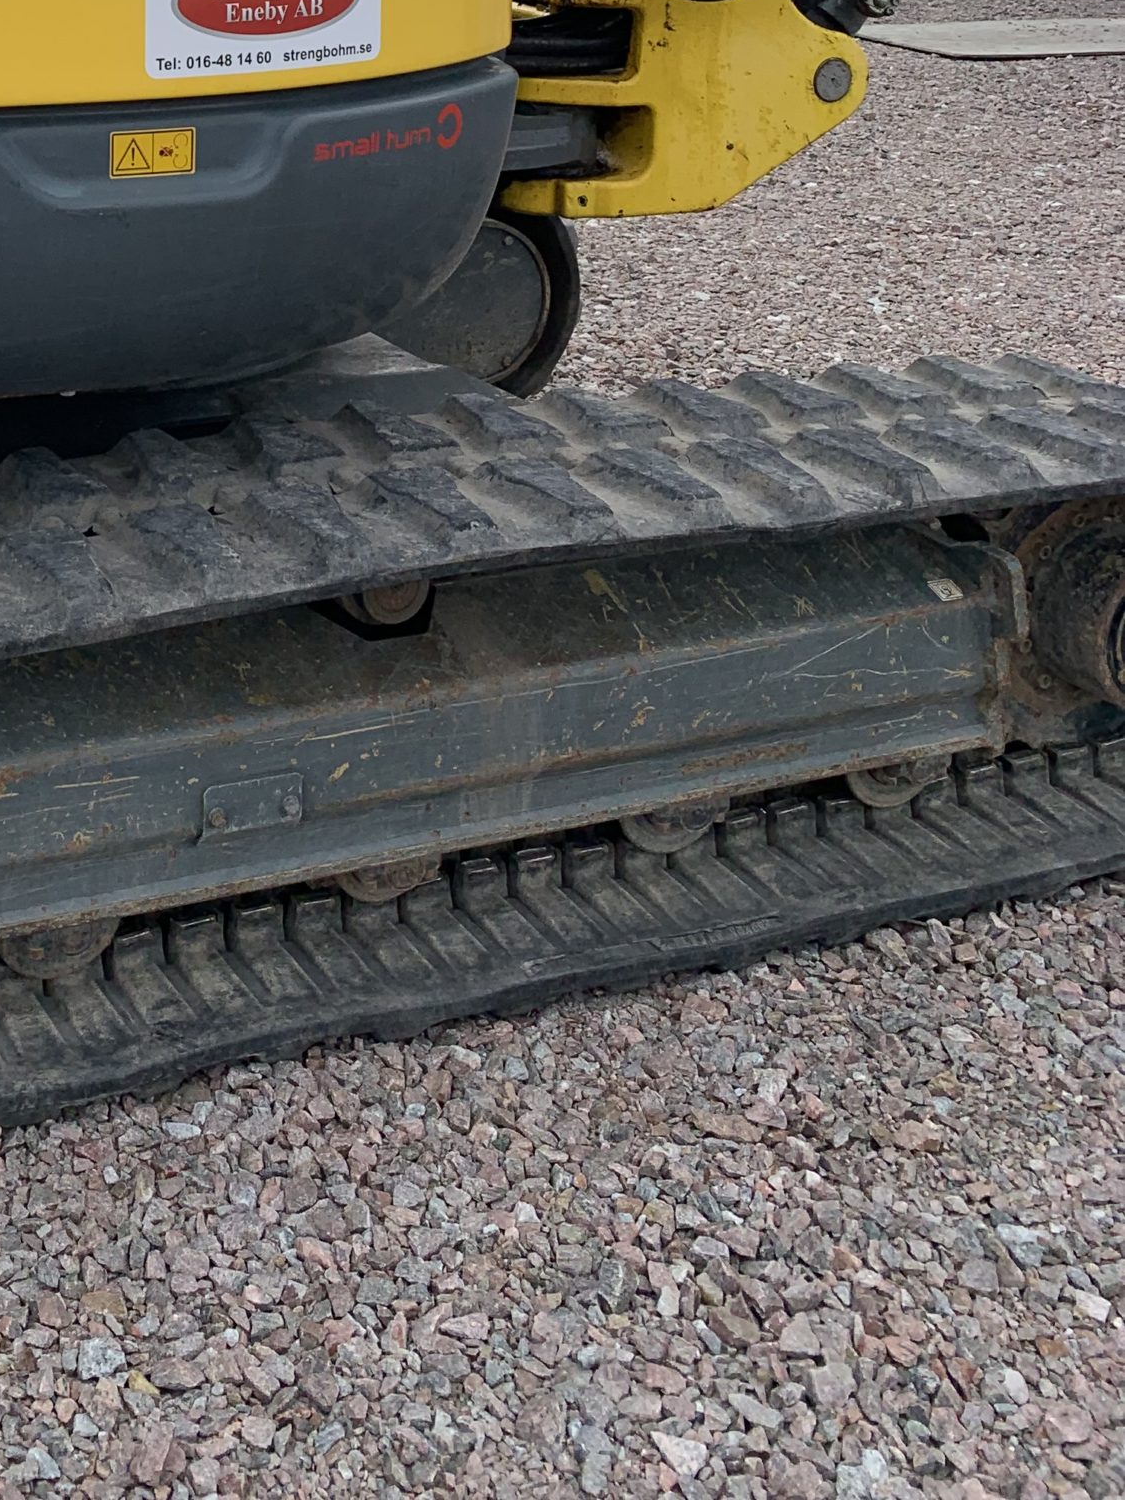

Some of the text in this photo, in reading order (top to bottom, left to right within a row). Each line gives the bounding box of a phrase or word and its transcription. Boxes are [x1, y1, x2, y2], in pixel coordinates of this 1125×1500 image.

[225, 1, 288, 25] Eneby
[156, 51, 272, 71] Tel: 016-48 14 60
[283, 42, 373, 63] strengbohm.se
[313, 126, 432, 162] small turn
